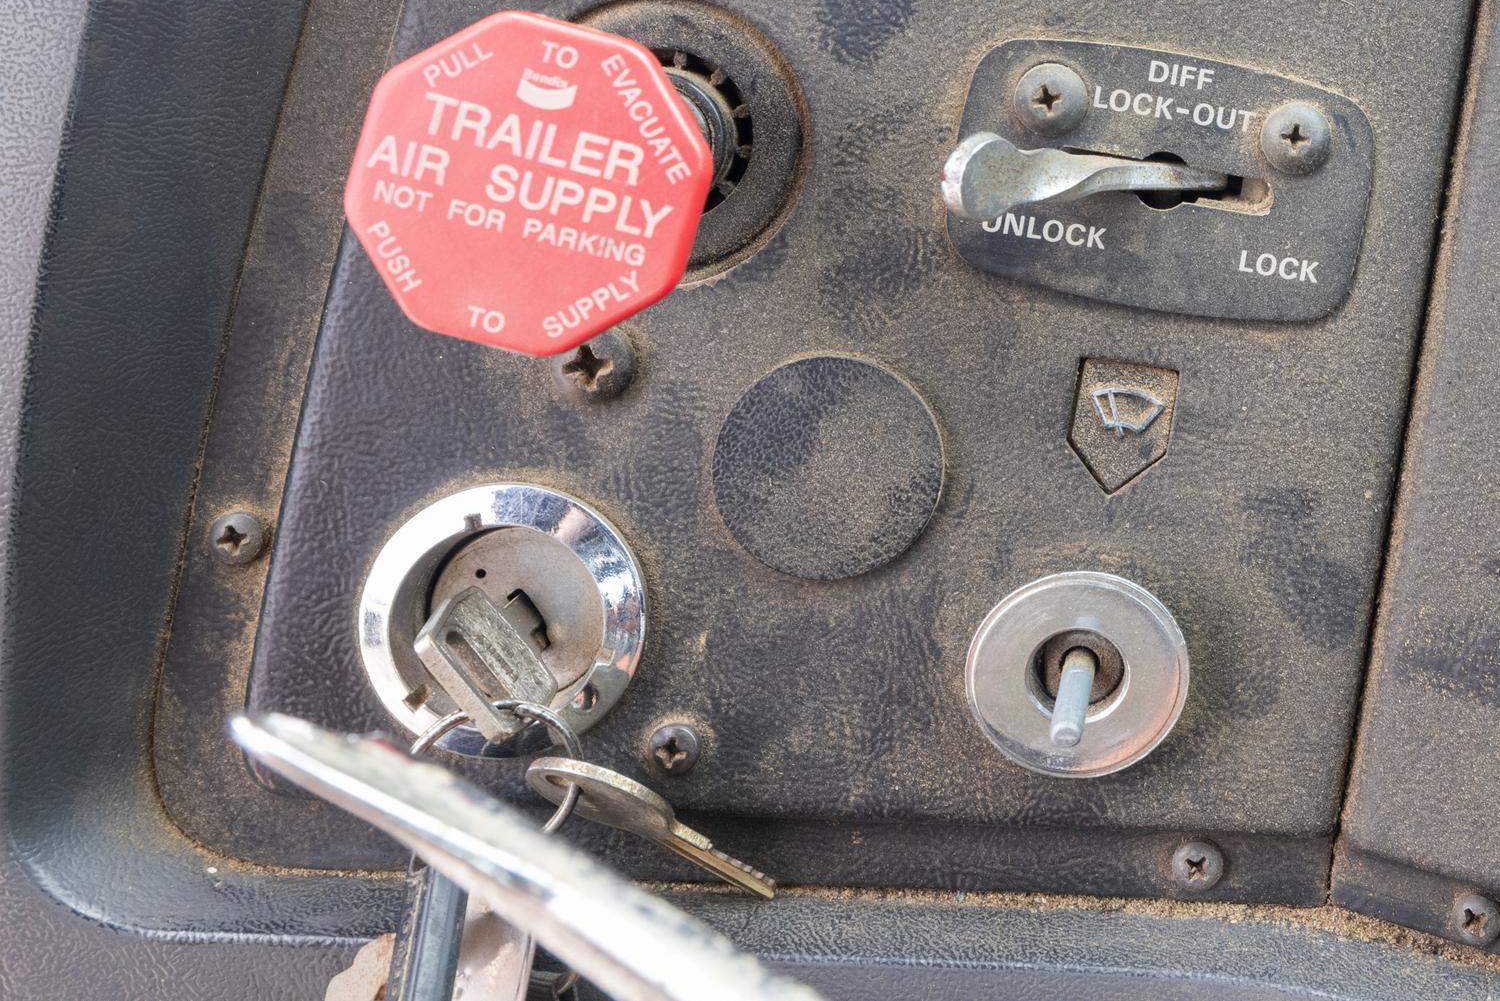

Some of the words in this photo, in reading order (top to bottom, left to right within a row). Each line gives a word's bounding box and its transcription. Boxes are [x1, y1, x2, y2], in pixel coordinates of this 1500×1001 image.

[423, 42, 494, 88] PULL
[542, 40, 579, 69] TO
[600, 54, 692, 185] EVACUATE
[1093, 85, 1257, 132] LOCK-OUT
[1148, 60, 1215, 90] DIFF
[425, 91, 645, 187] TRAILER
[367, 135, 450, 187] AIR
[485, 163, 674, 240] SUPPLY
[373, 180, 434, 214] NOT
[447, 200, 507, 233] FOR
[521, 218, 646, 268] PARKING
[367, 220, 423, 294] PUSH
[467, 305, 505, 334] TO
[542, 270, 640, 339] SUPPLY
[1238, 250, 1320, 283] LOCK
